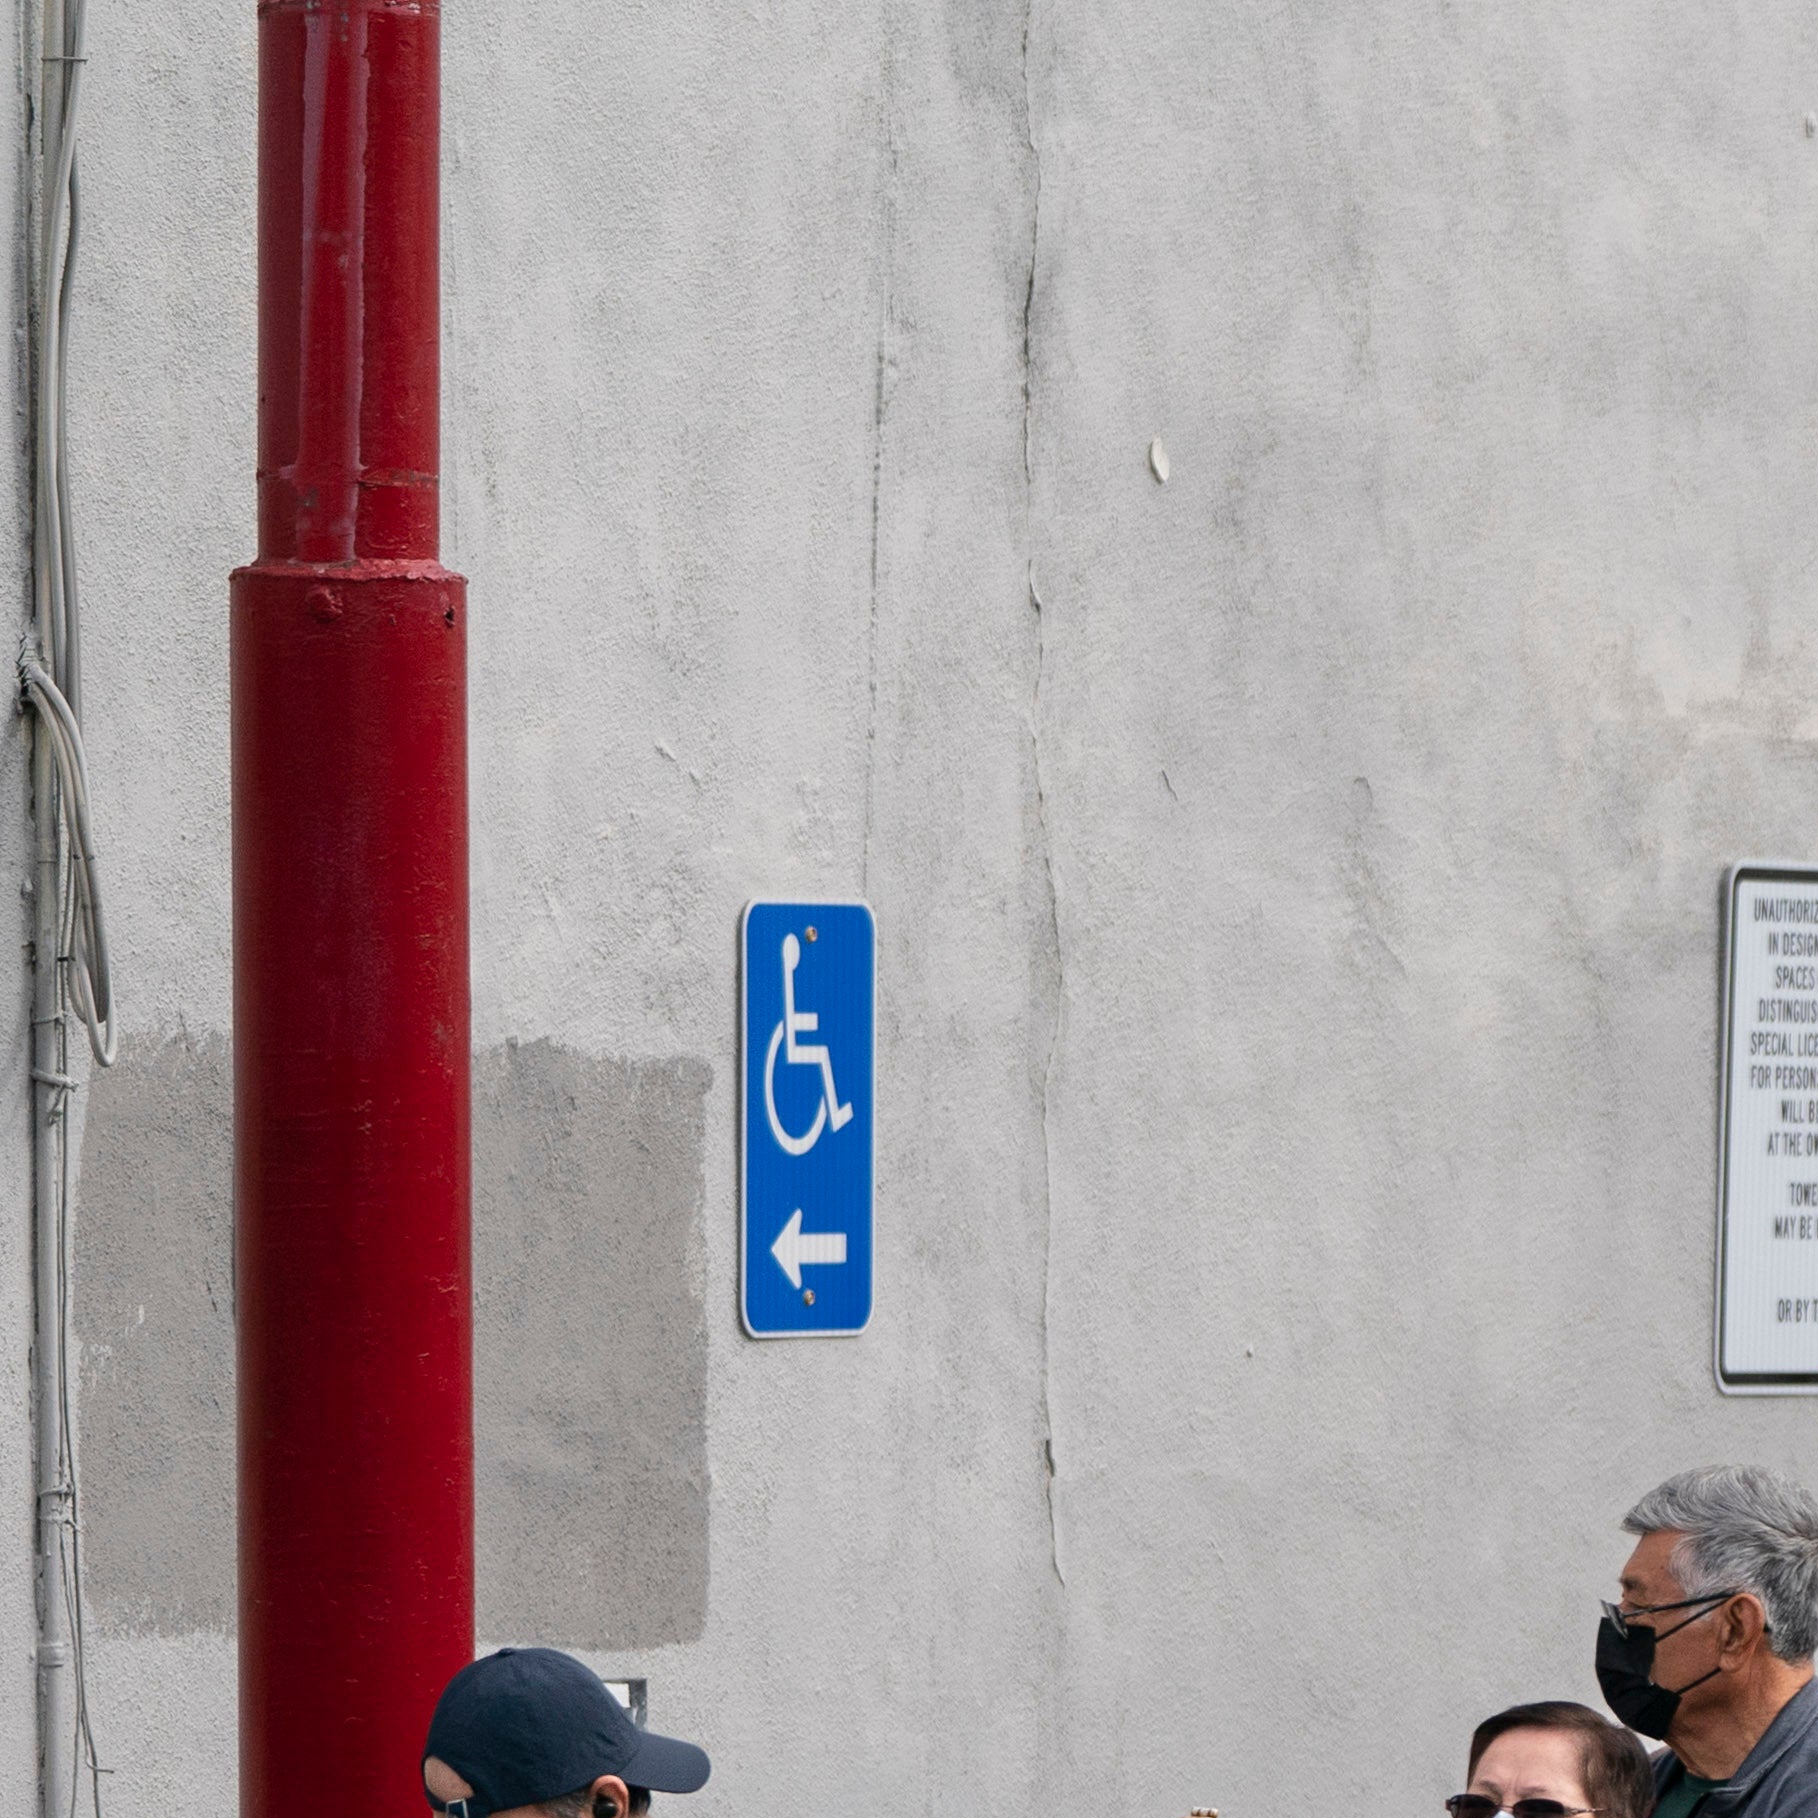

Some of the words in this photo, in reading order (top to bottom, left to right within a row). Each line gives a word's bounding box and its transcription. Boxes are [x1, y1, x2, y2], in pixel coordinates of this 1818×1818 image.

[1768, 932, 1779, 955] IN
[1775, 965, 1815, 990] SPACES
[1750, 1032, 1794, 1056] SPECIAL
[1750, 1065, 1772, 1089] FOR
[1781, 1100, 1804, 1123] WILL
[1767, 1132, 1780, 1156] AT
[1783, 1133, 1802, 1156] THE
[1774, 1216, 1796, 1239] MAY
[1800, 1216, 1813, 1239] BE
[1777, 1299, 1792, 1323] OR
[1796, 1299, 1810, 1323] BY
